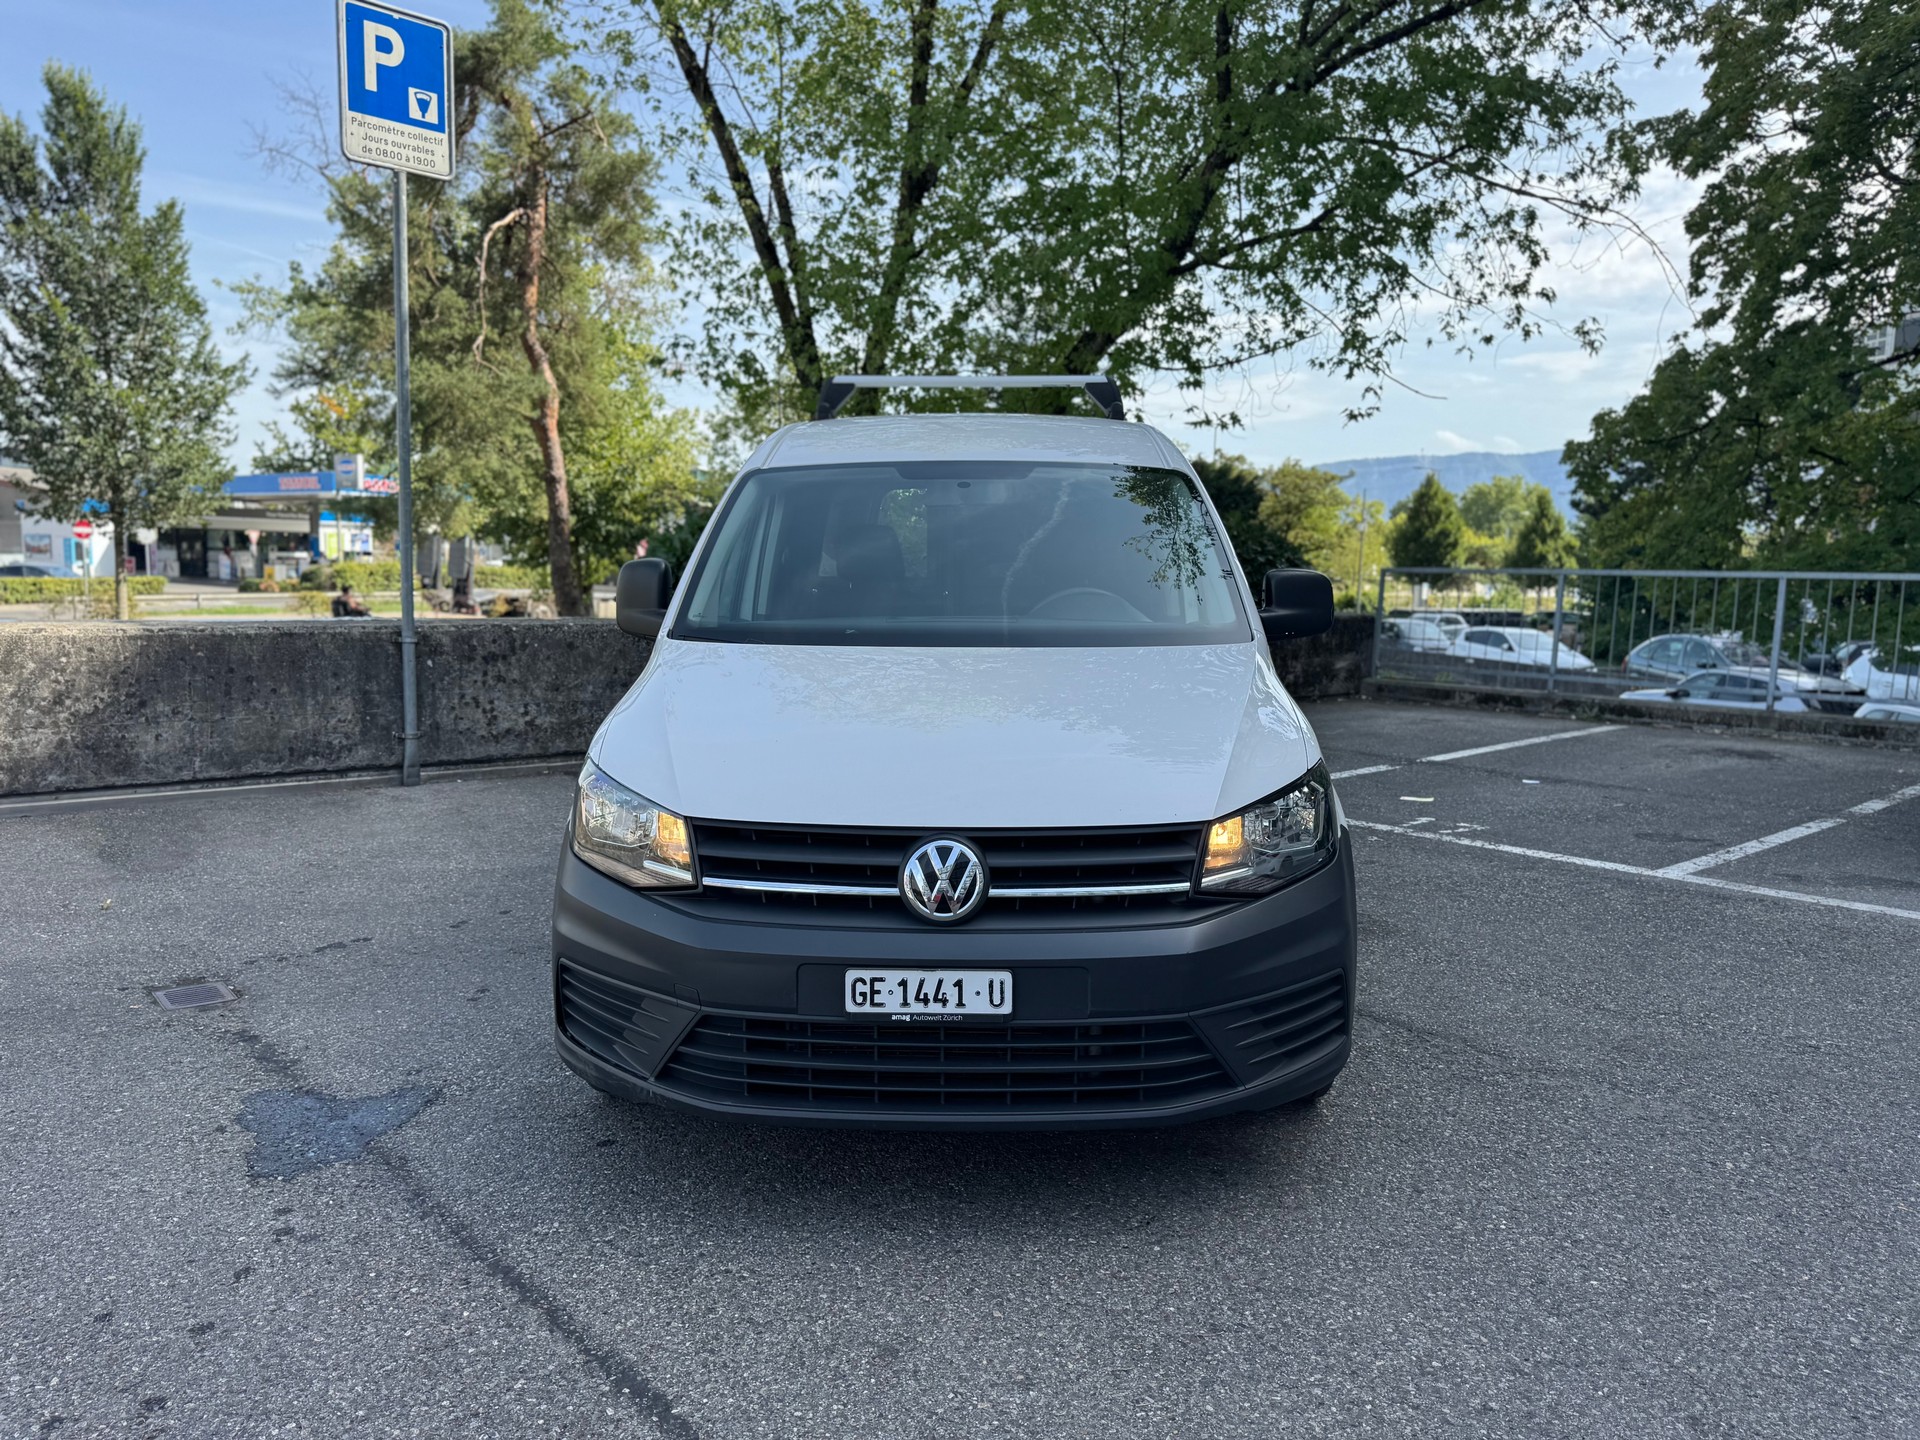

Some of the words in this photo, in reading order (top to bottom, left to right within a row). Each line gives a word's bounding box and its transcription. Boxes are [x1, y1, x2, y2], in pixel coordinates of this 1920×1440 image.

[363, 19, 405, 93] P
[351, 116, 405, 138] Parcomètre
[407, 128, 444, 146] collectif
[361, 144, 373, 155] de
[405, 153, 411, 163] à
[362, 132, 389, 146] Jours
[391, 139, 435, 157] ouvrables
[891, 1014, 911, 1022] amag
